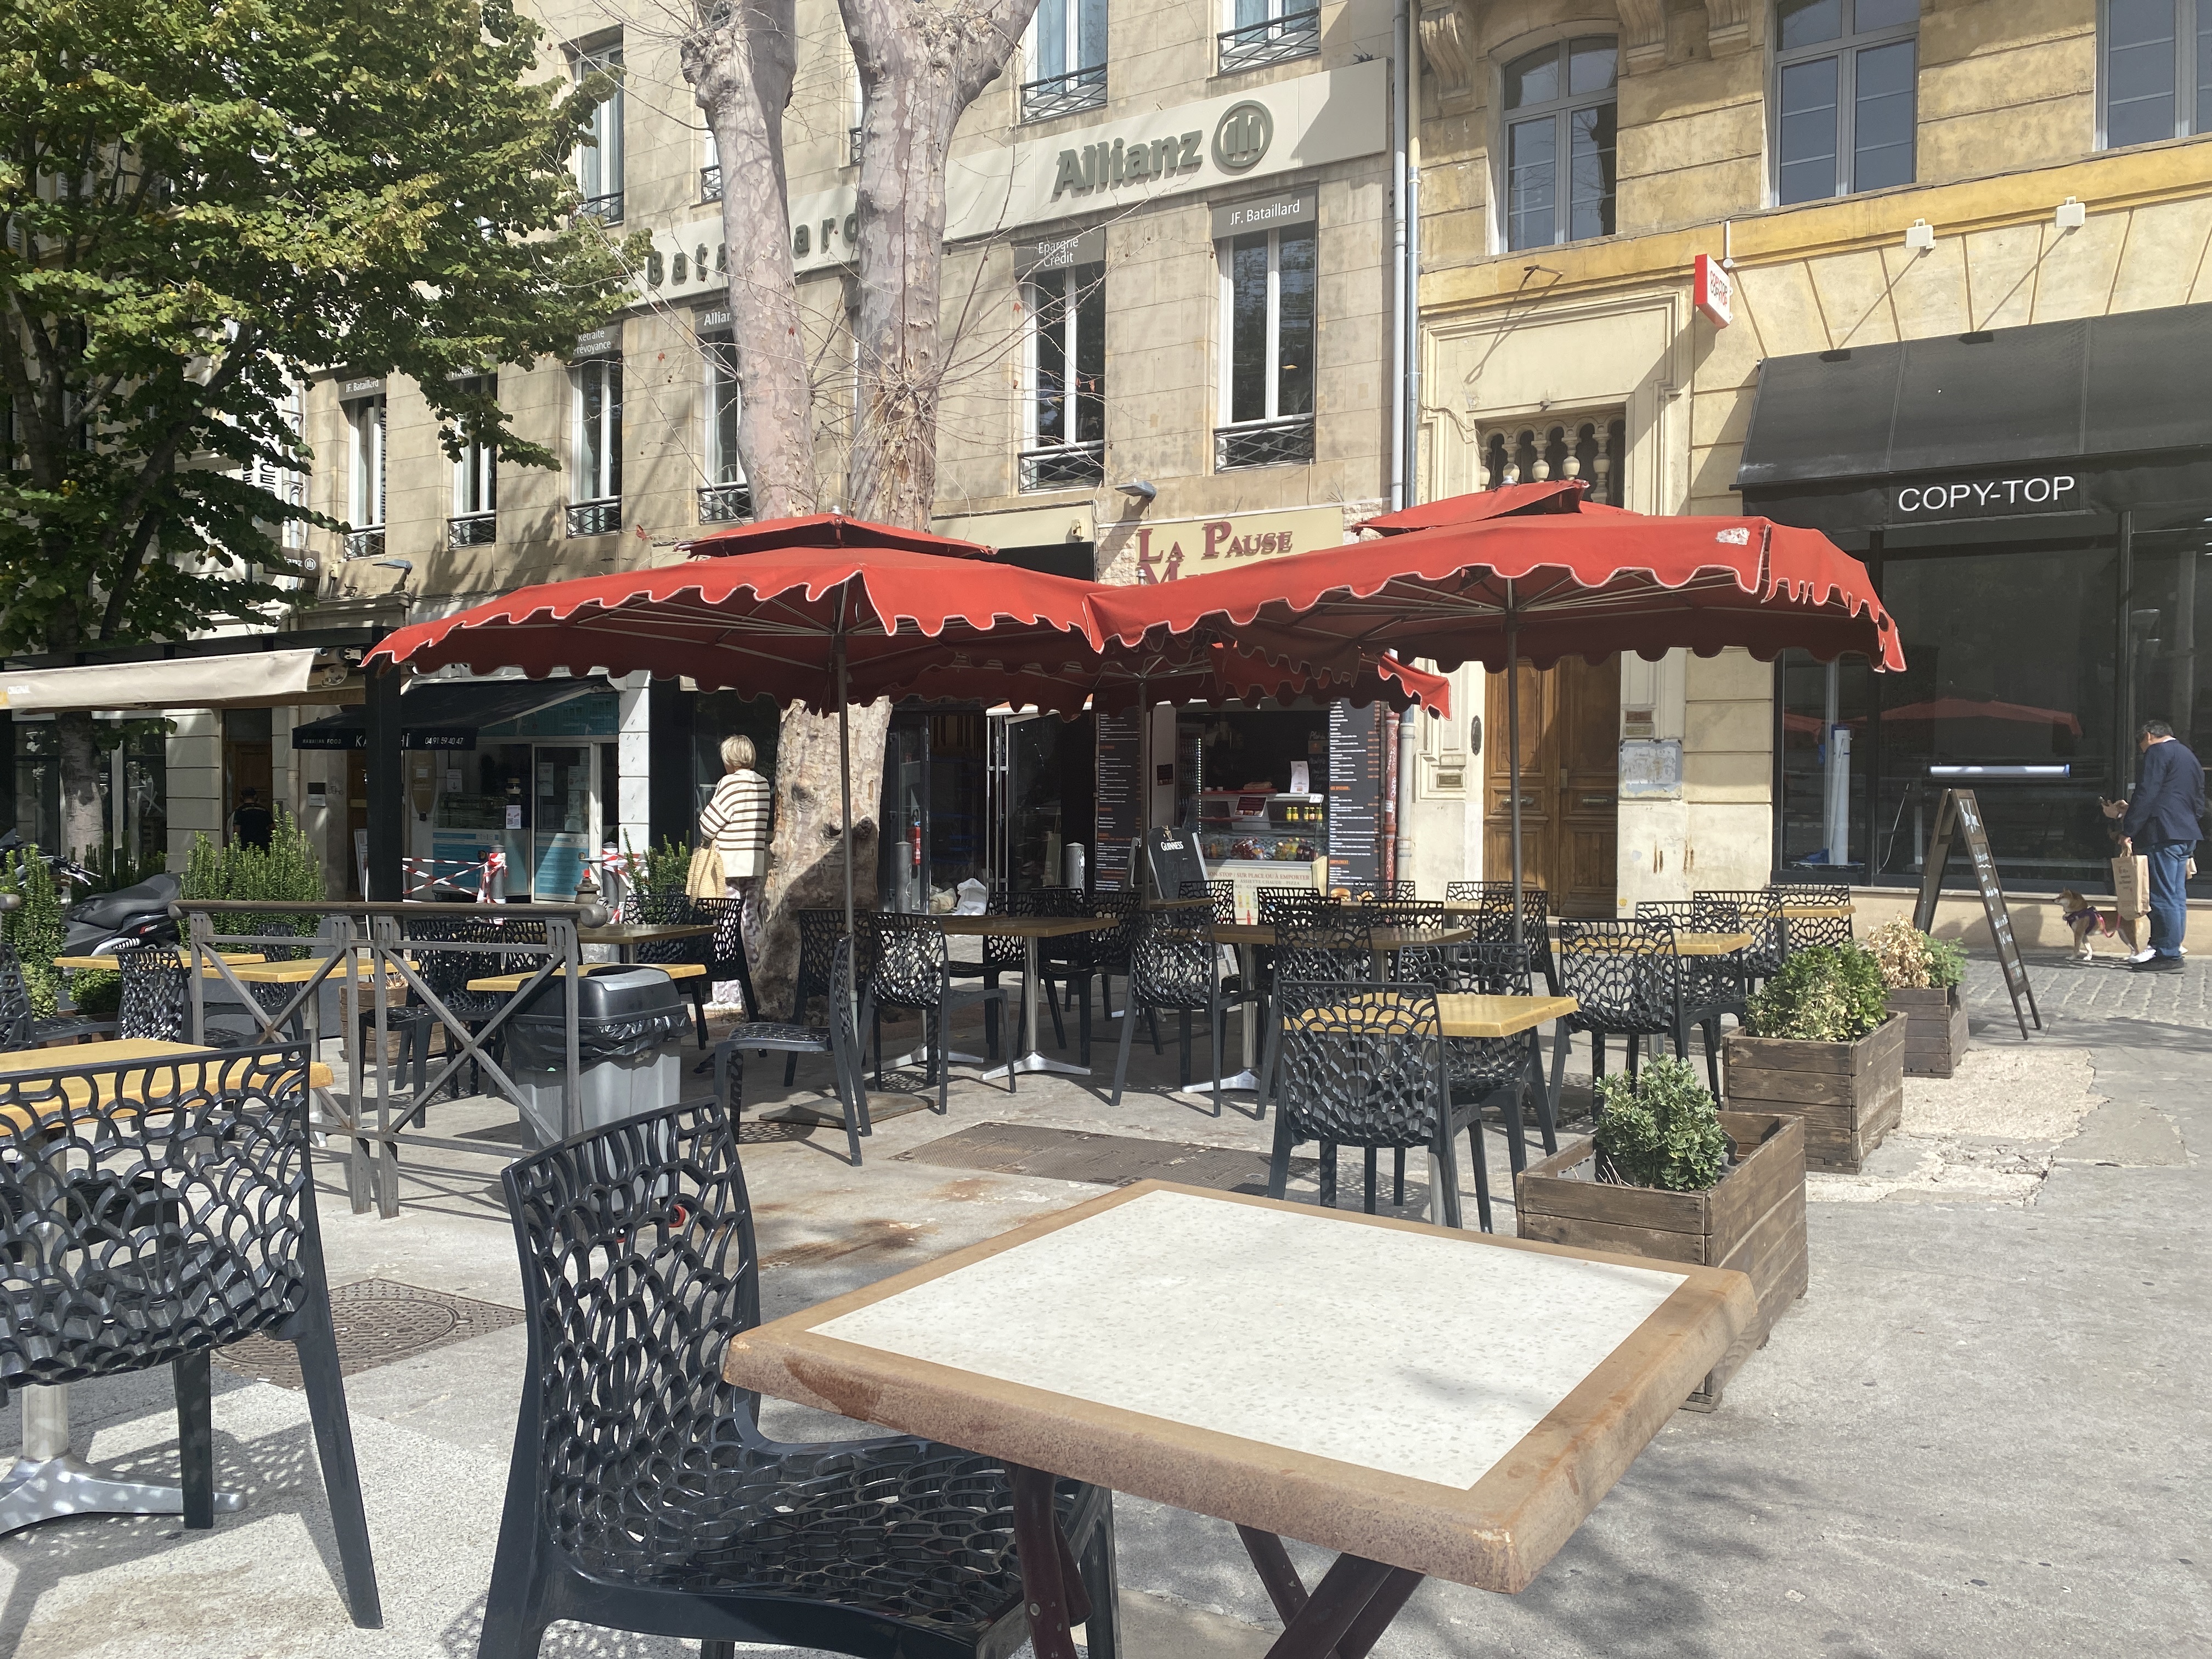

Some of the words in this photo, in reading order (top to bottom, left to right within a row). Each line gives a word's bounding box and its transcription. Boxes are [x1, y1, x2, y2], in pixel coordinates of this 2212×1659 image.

[1053, 129, 1203, 194] Allianz
[1231, 212, 1244, 225] JF.
[1247, 199, 1300, 222] Bataillard
[1039, 238, 1079, 256] Epargne
[1043, 251, 1074, 267] Crédit
[353, 379, 379, 391] Bataillard
[1898, 476, 2075, 511] COPY-TOP
[1161, 841, 1184, 851] GUINNESS
